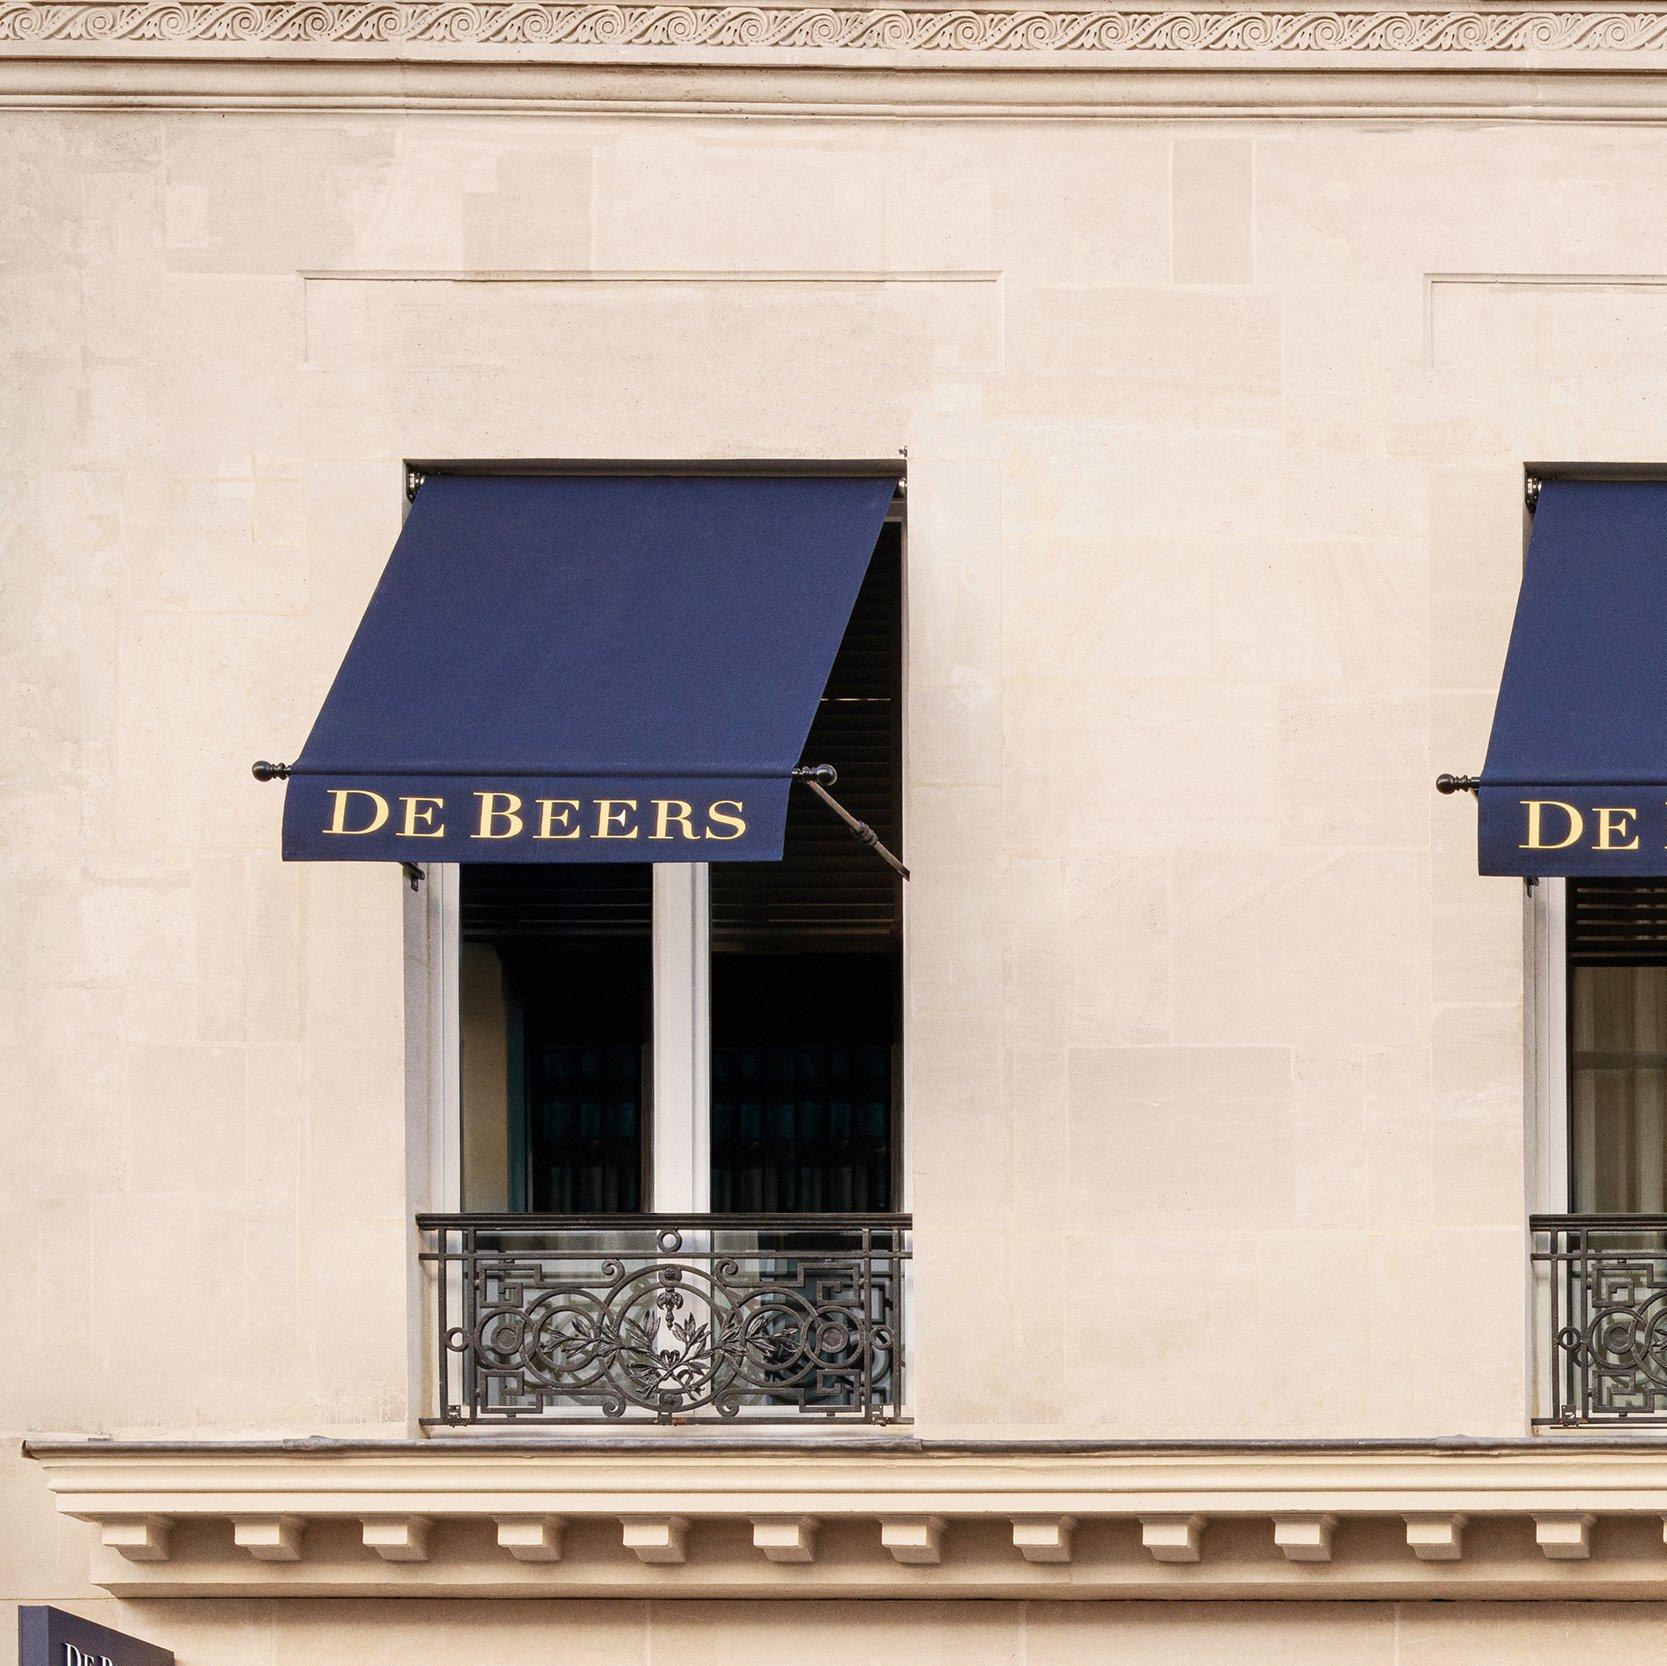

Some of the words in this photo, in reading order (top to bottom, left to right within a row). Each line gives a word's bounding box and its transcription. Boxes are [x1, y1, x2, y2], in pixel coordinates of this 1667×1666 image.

[321, 787, 446, 838] DE
[471, 790, 747, 842] BEERS
[1518, 799, 1640, 851] DE
